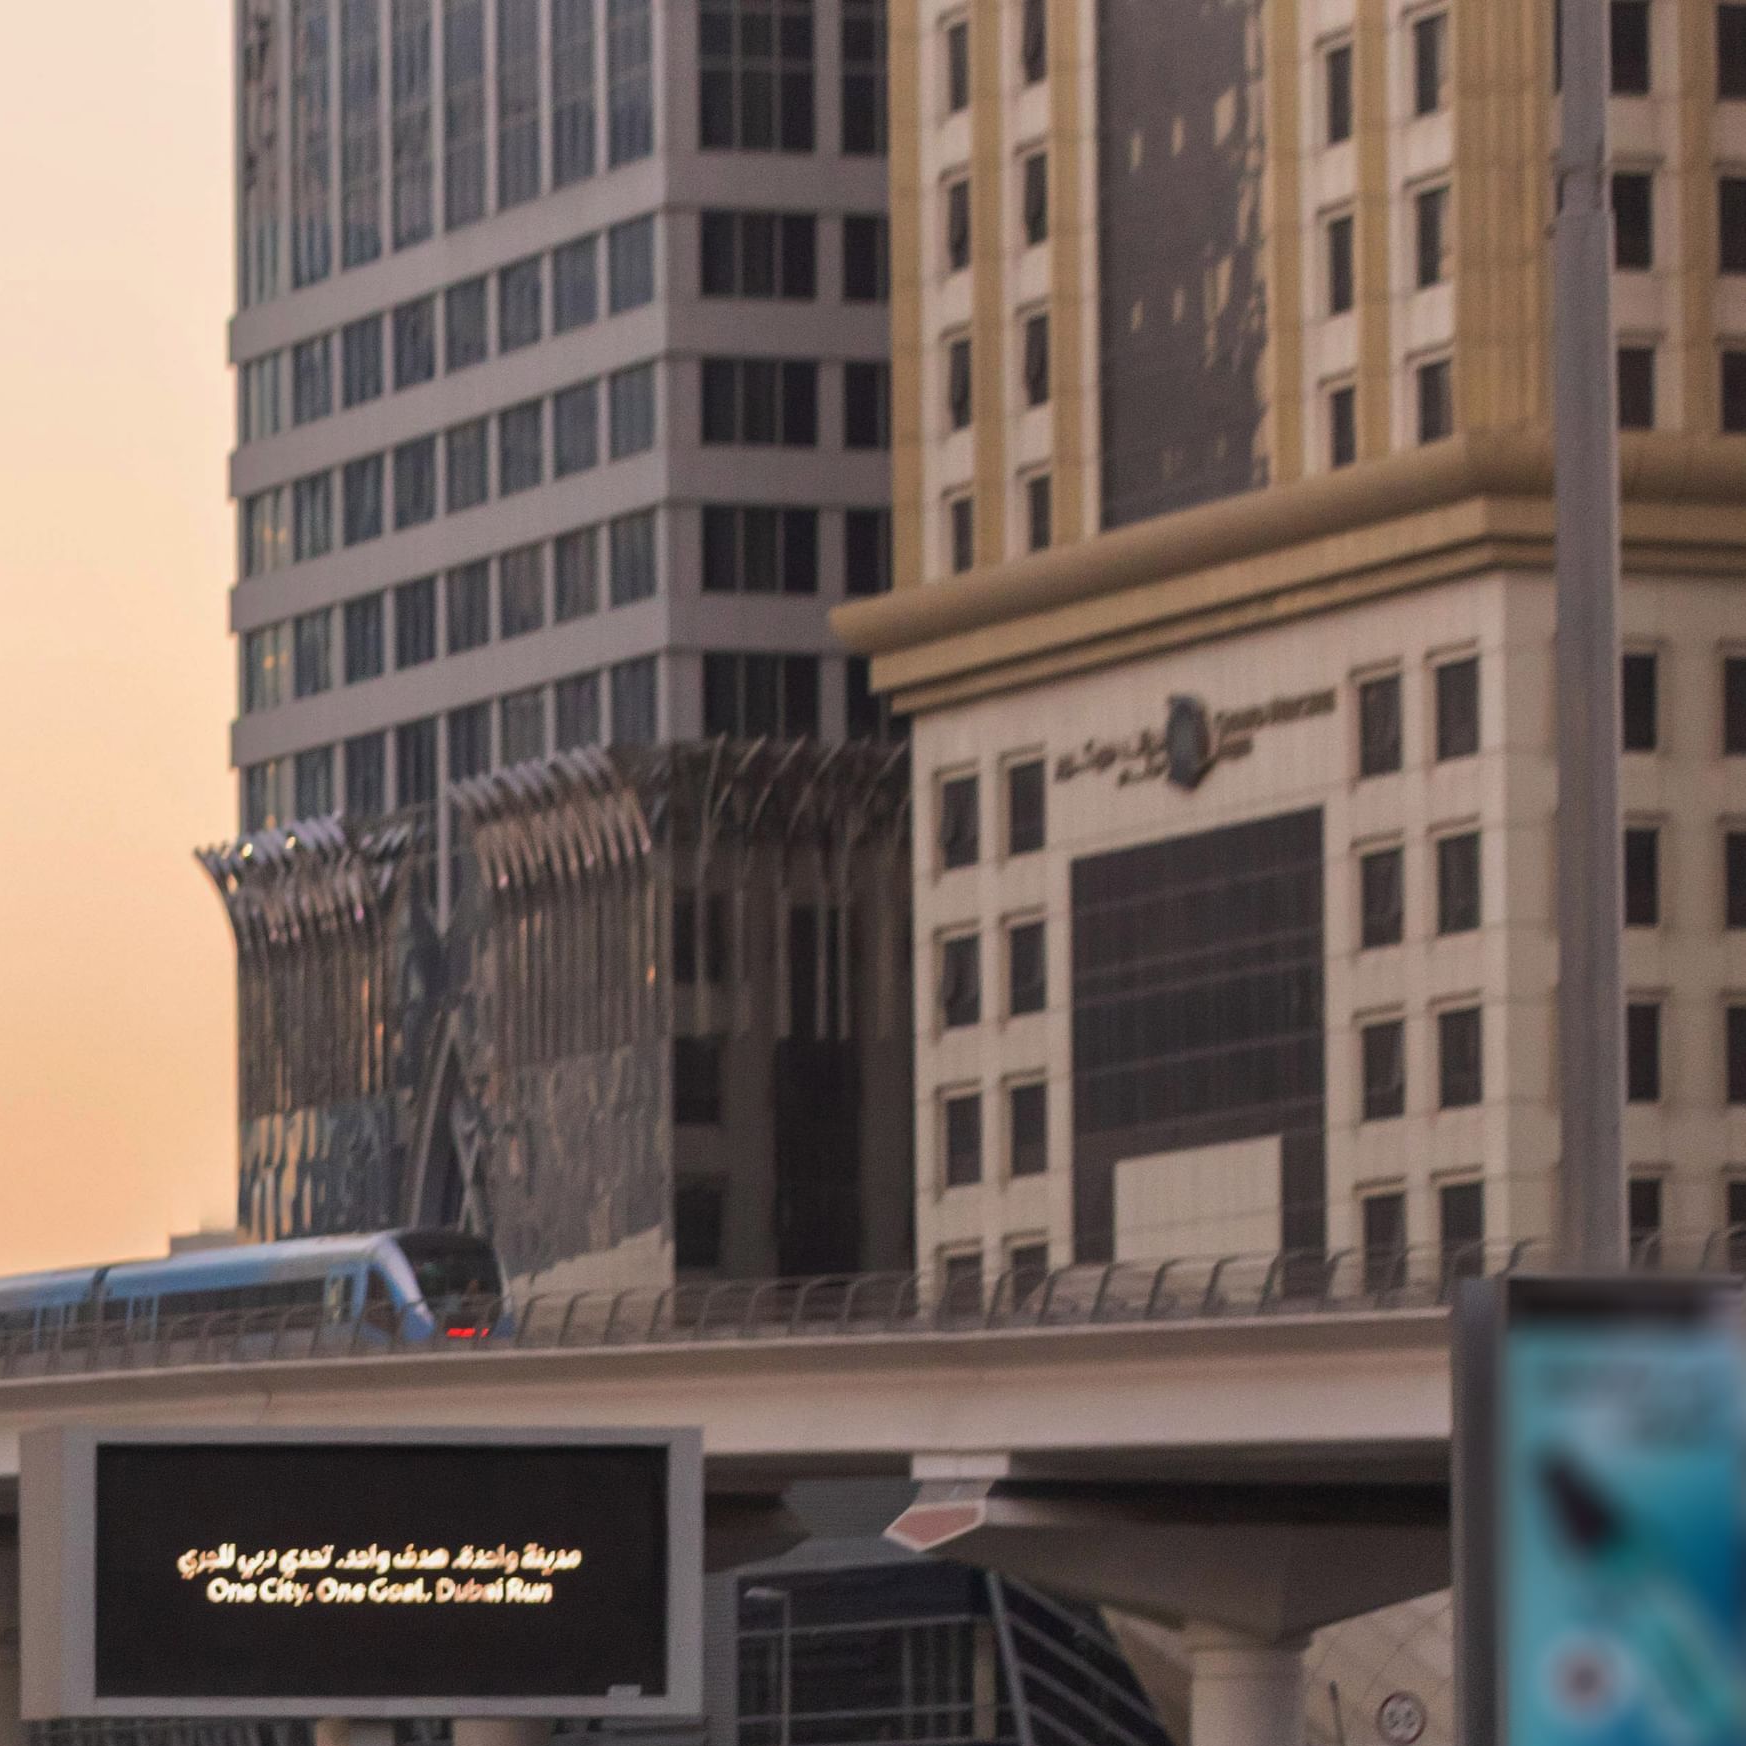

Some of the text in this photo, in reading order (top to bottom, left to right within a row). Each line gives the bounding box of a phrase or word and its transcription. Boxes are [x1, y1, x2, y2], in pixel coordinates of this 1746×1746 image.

[207, 1578, 258, 1602] One
[316, 1578, 366, 1602] One
[435, 1577, 504, 1602] Dubai
[505, 1577, 553, 1602] Run
